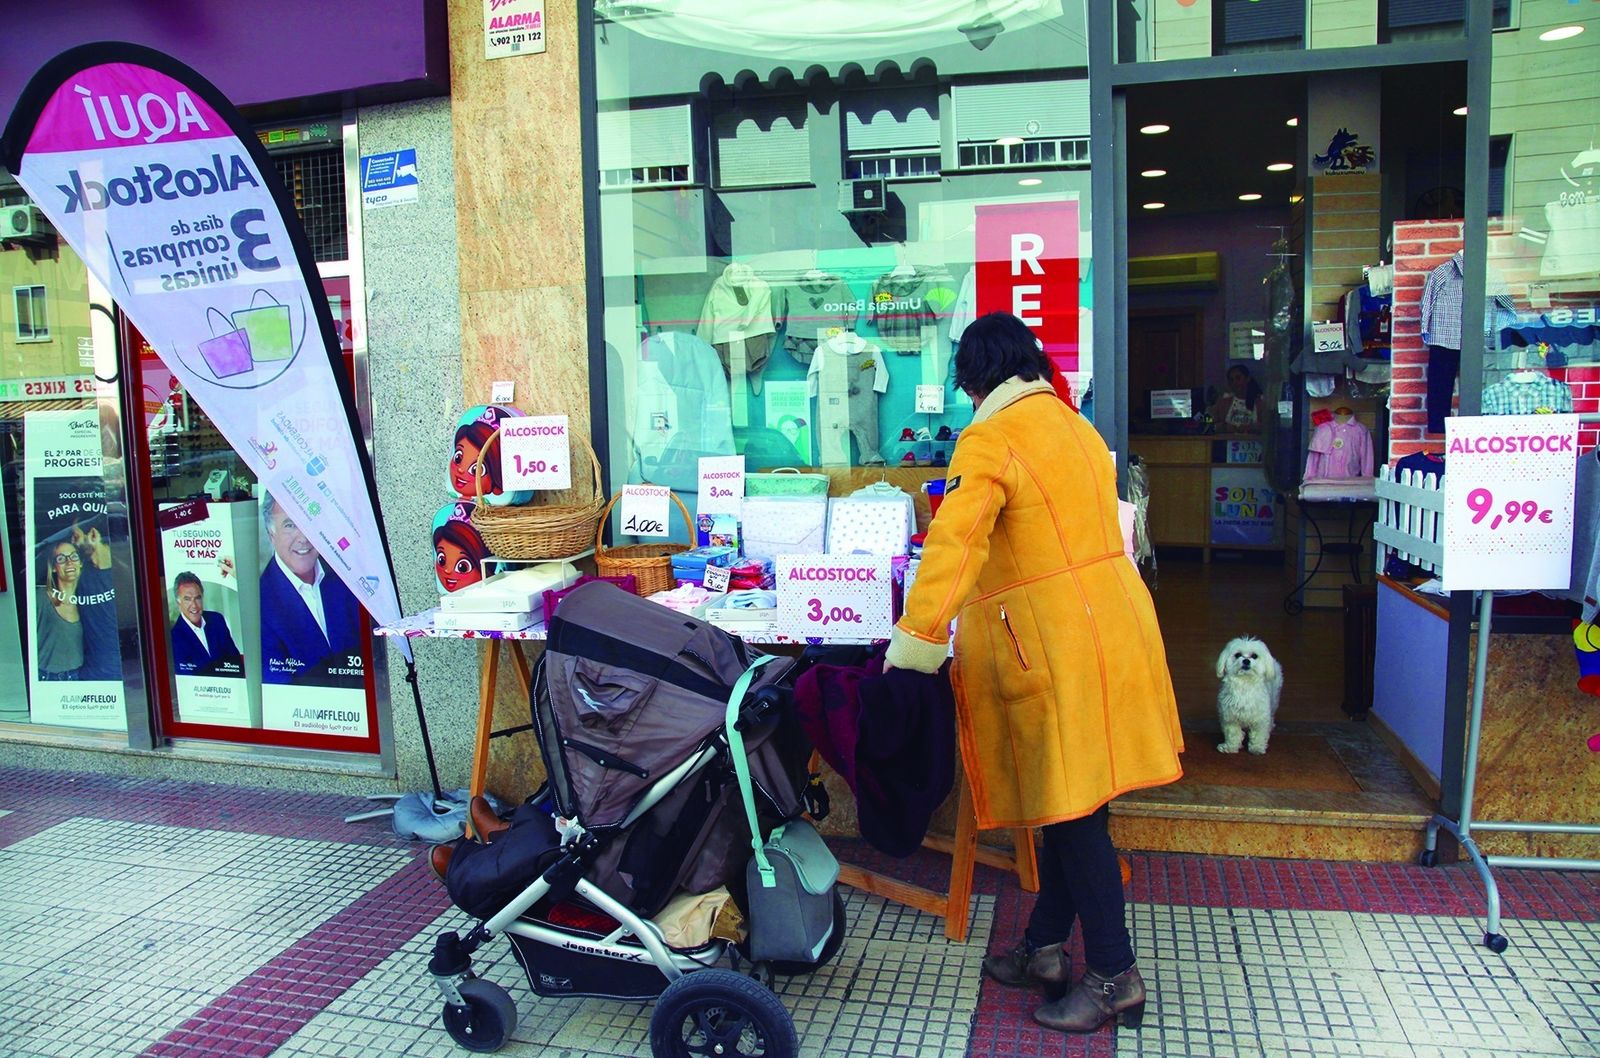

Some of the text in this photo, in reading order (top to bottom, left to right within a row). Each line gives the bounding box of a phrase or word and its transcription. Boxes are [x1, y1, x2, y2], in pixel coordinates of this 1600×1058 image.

[489, 11, 541, 29] ALARMA
[496, 31, 542, 46] 902 121 122
[365, 195, 388, 205] tyco
[1011, 233, 1046, 351] RE
[504, 426, 565, 438] ALCOSTOCK
[1449, 434, 1573, 454] ALCOSTOCK
[65, 449, 81, 457] PAR
[44, 458, 103, 468] PROGRESI
[513, 454, 559, 477] 1,50 €
[702, 472, 741, 480] ALCOSTOCK
[78, 491, 92, 499] ESTE
[625, 487, 669, 498] ALCOSTOCK
[709, 486, 733, 499] 3,00€
[1215, 487, 1257, 503] SOL
[47, 503, 79, 520] PARA
[1215, 503, 1273, 518] LUNA
[1466, 487, 1553, 531] 9,99€
[183, 530, 221, 538] SEGUNDO
[174, 538, 222, 548] AUDÍFONO
[186, 548, 217, 559] 1€ MÁS
[788, 567, 877, 581] ALCOSTOCK
[52, 587, 66, 601] TÚ
[807, 598, 863, 626] 3,00€
[347, 655, 362, 667] 30
